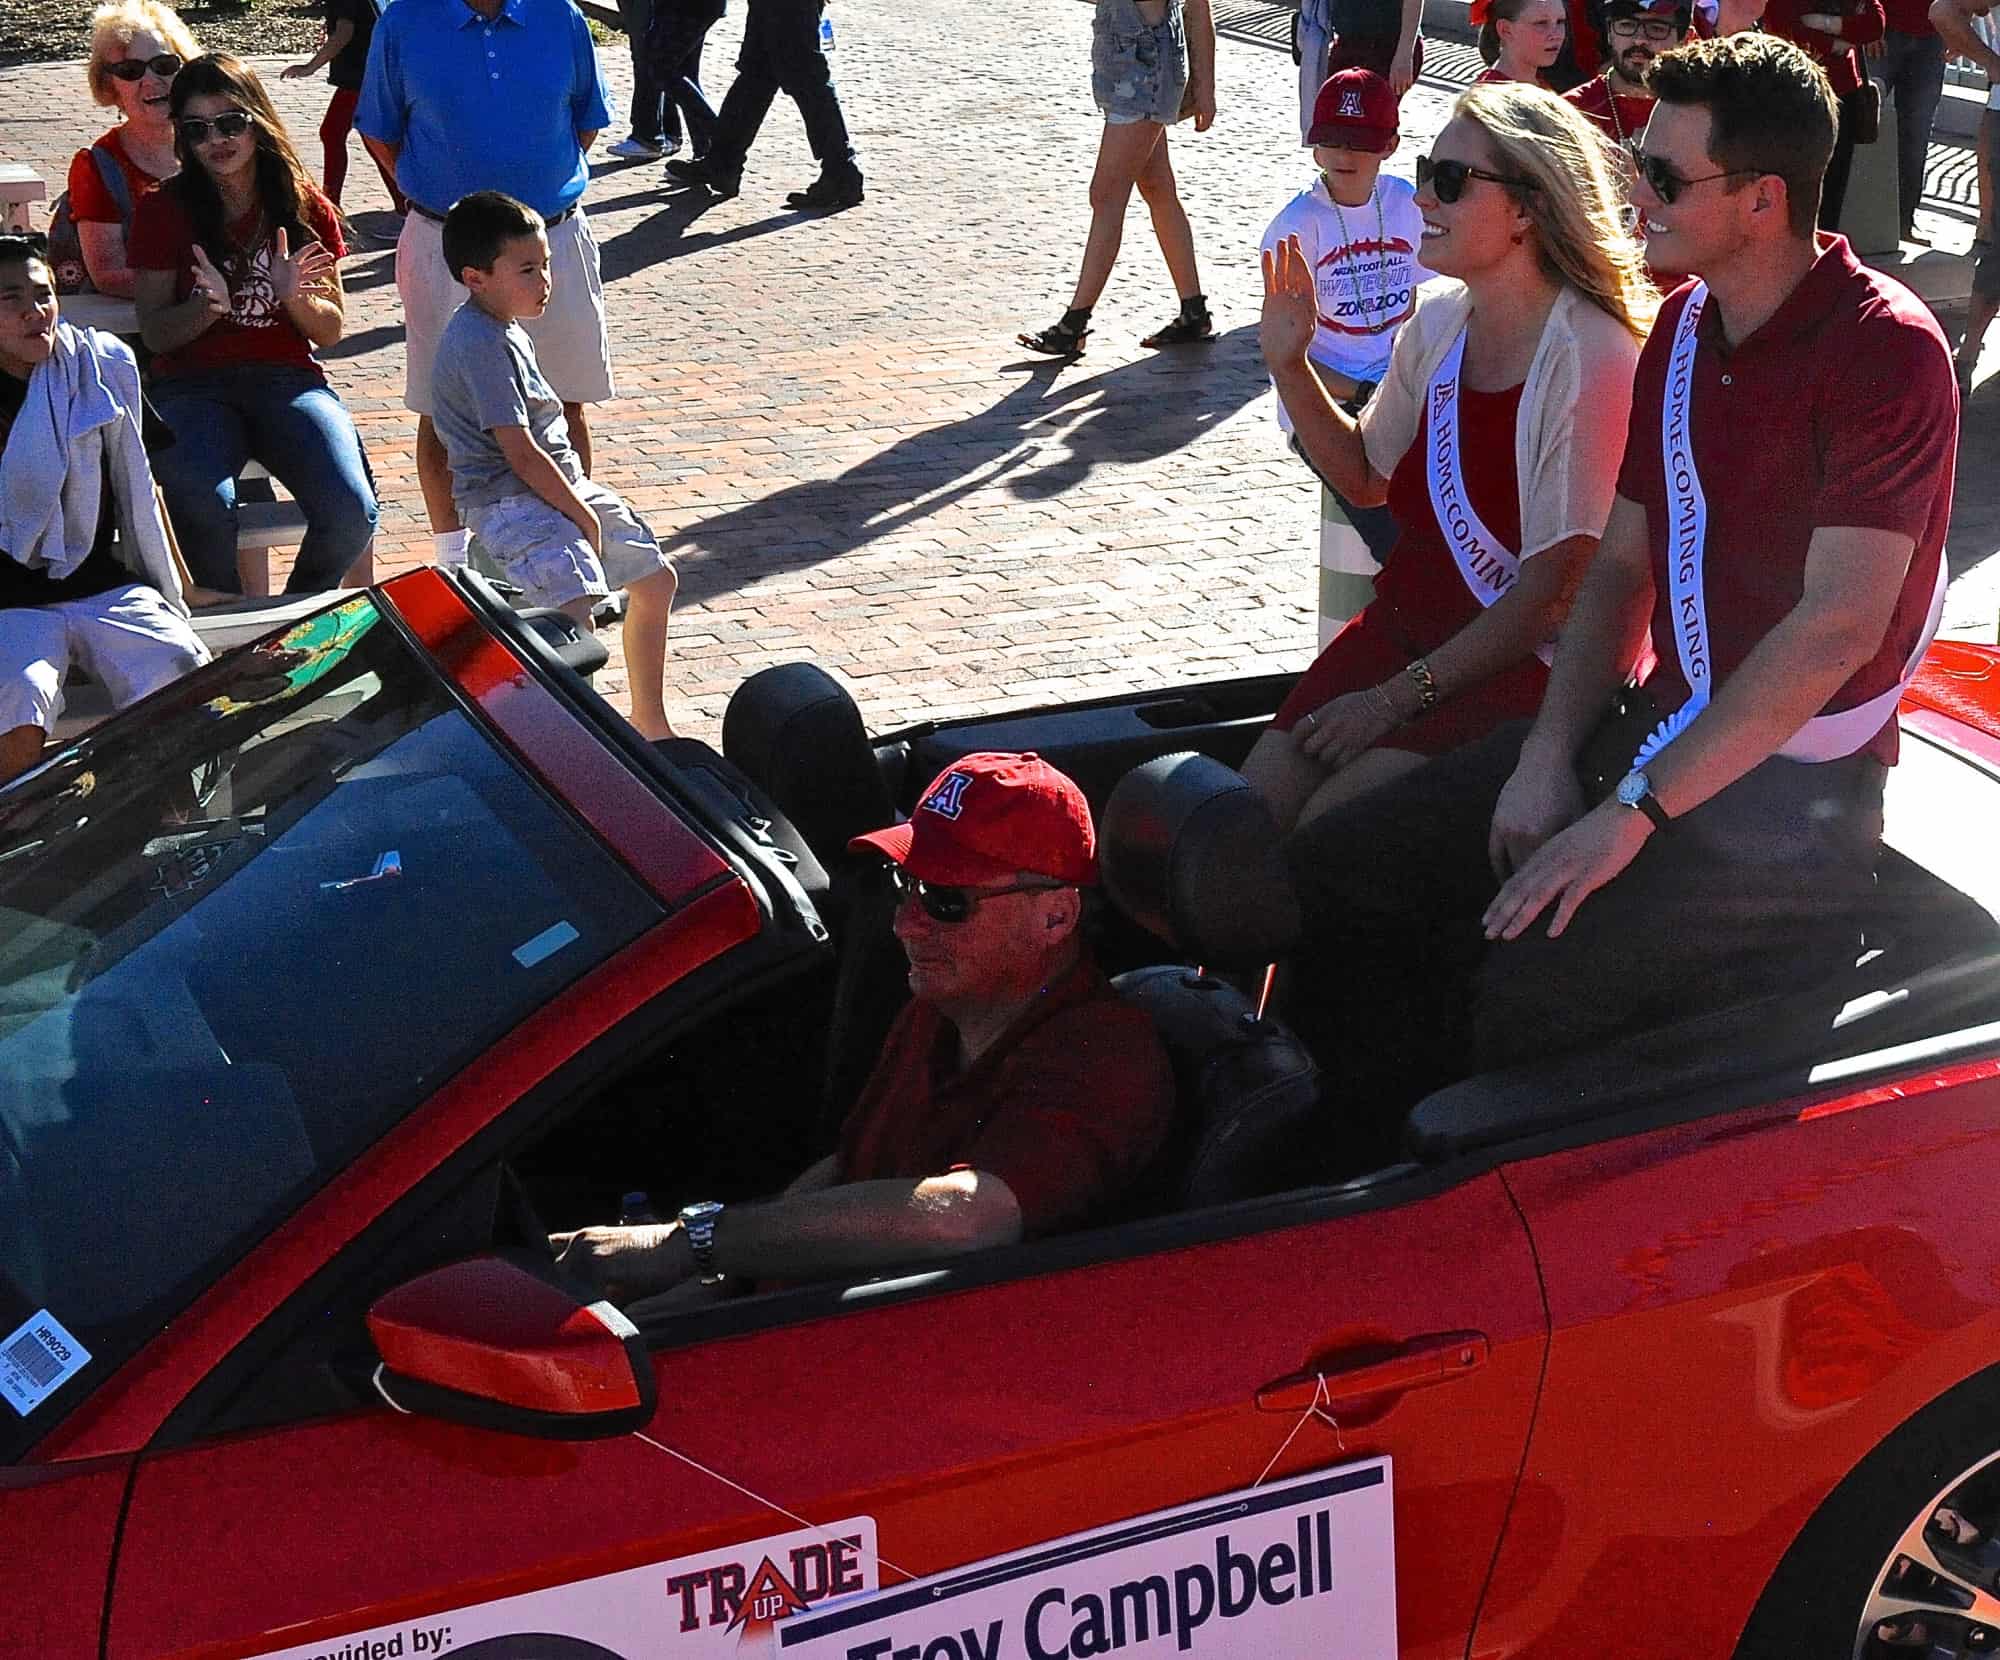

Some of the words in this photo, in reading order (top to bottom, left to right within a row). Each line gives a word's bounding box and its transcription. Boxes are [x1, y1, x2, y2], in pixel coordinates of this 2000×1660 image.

[1337, 90, 1365, 116] A
[1669, 351, 1697, 584] HOMECOMING
[1437, 420, 1515, 590] HOMECOMIN
[1681, 593, 1707, 679] KING
[923, 771, 974, 821] A
[35, 1326, 72, 1362] HR9029
[666, 1534, 865, 1636] TRADE
[753, 1594, 784, 1620] UP
[1023, 1510, 1334, 1660] Campbell
[307, 1632, 403, 1660] vided
[412, 1626, 452, 1653] by:
